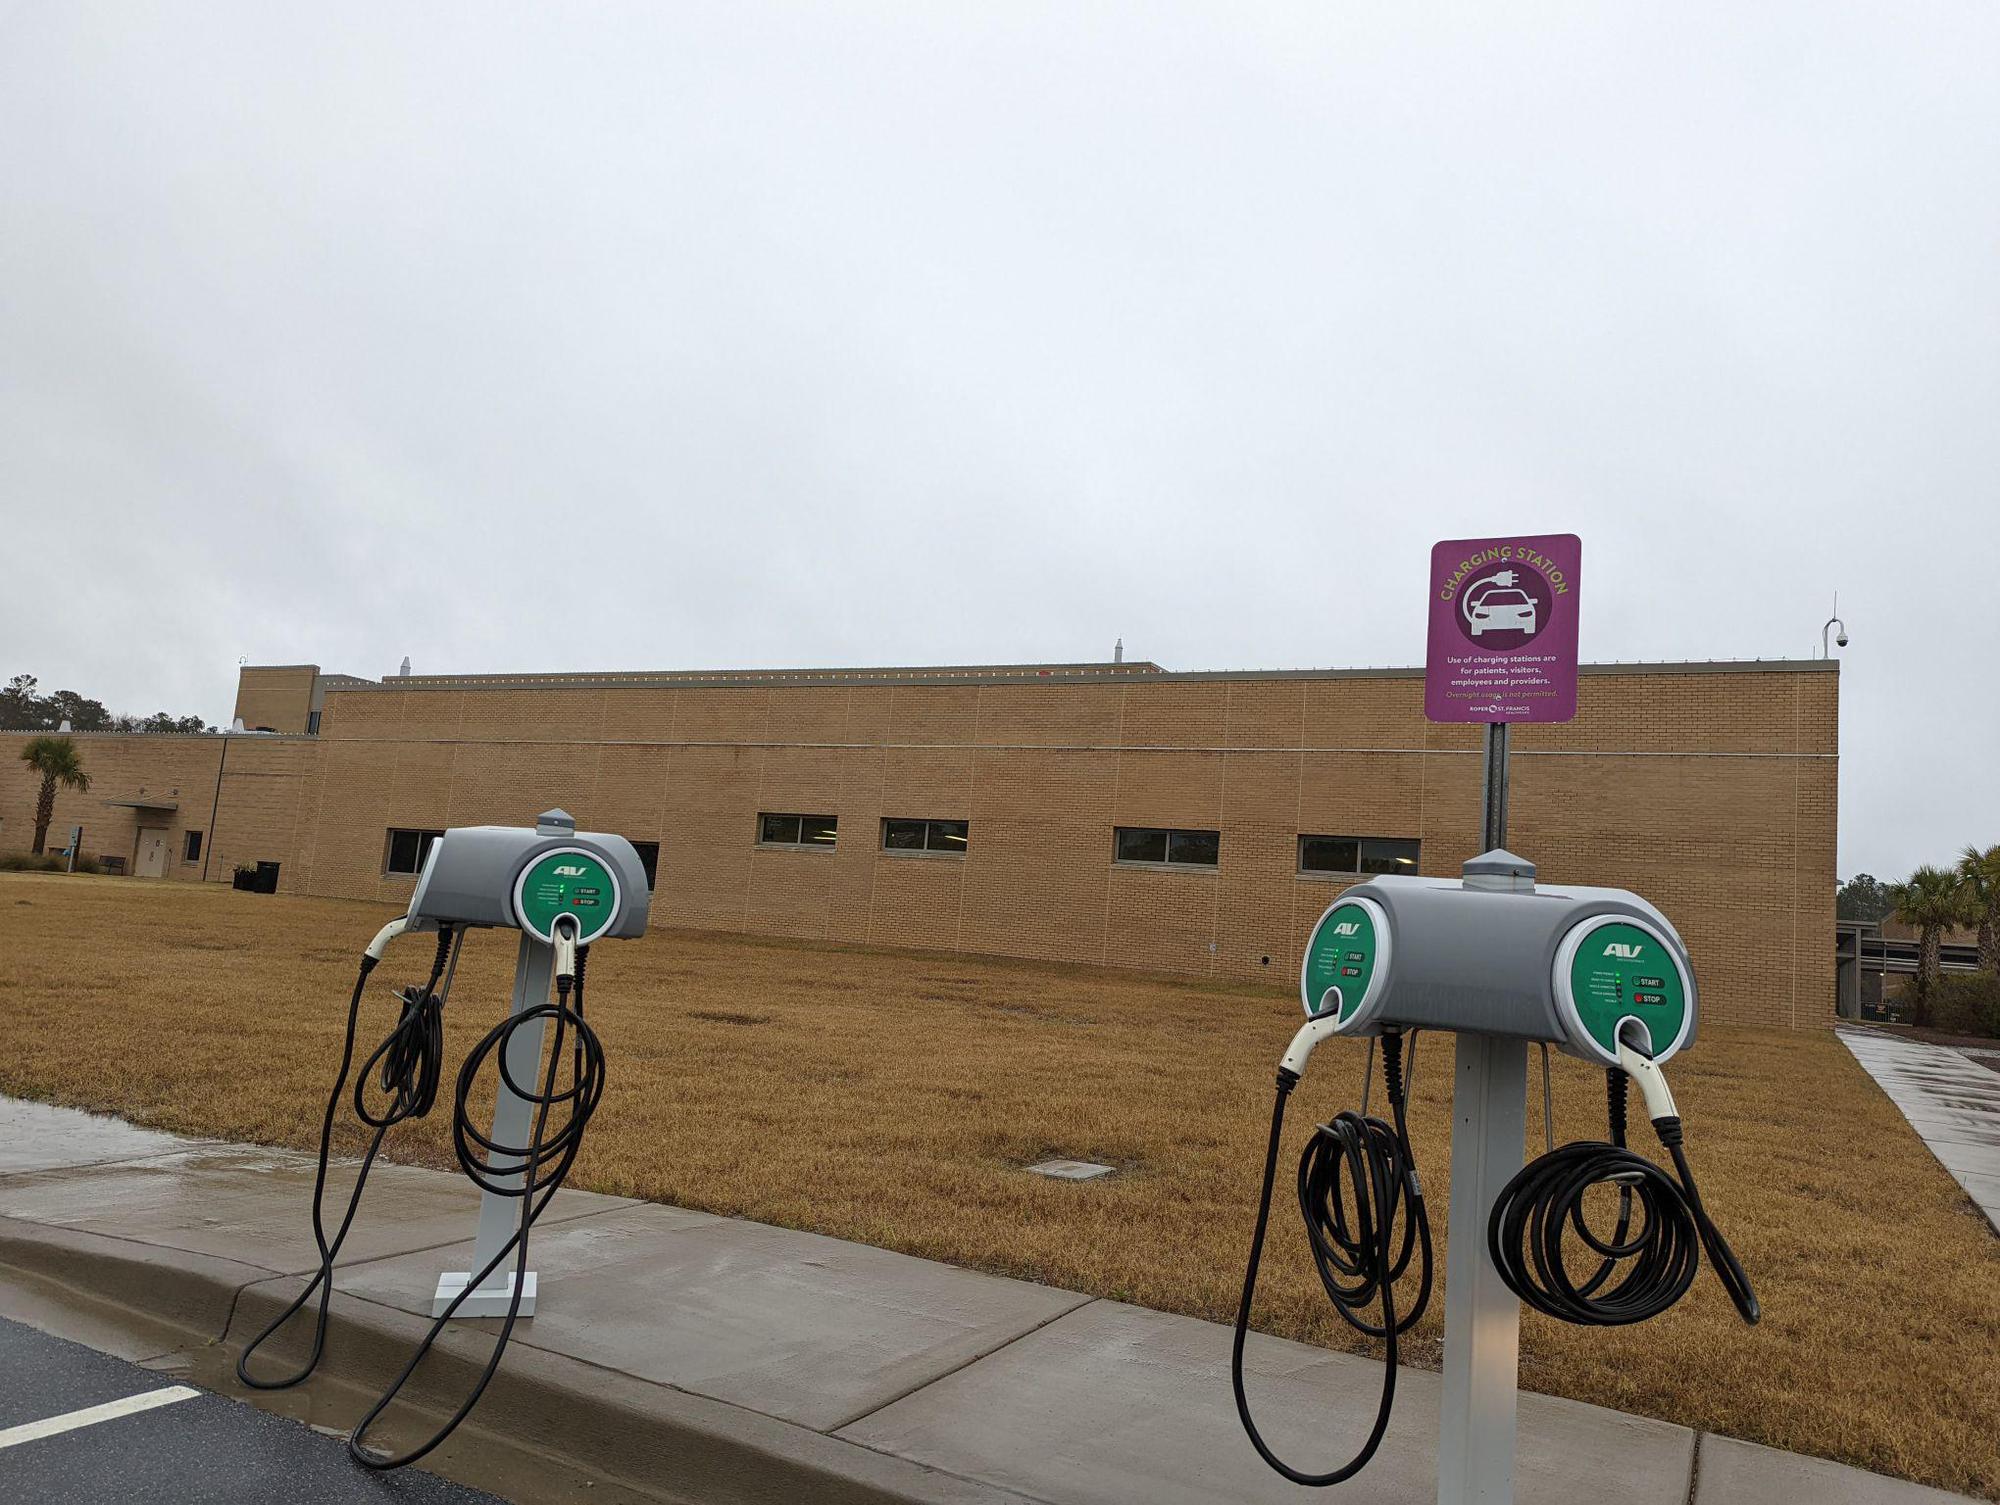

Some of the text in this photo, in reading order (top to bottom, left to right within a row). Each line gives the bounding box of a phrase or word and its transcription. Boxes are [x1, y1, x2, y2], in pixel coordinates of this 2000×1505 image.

[1441, 546, 1568, 601] CHARGING STATION
[1447, 656, 1462, 664] Use
[1473, 656, 1508, 665] charging
[1510, 655, 1541, 663] stations
[1474, 667, 1508, 675] patients,
[1510, 666, 1542, 674] visitors,
[1451, 679, 1492, 687] employees
[1510, 677, 1550, 686] providers.
[1446, 691, 1480, 699] Overnight
[1521, 689, 1558, 699] permitted.
[1347, 968, 1359, 976] STOP
[1641, 978, 1660, 987] START
